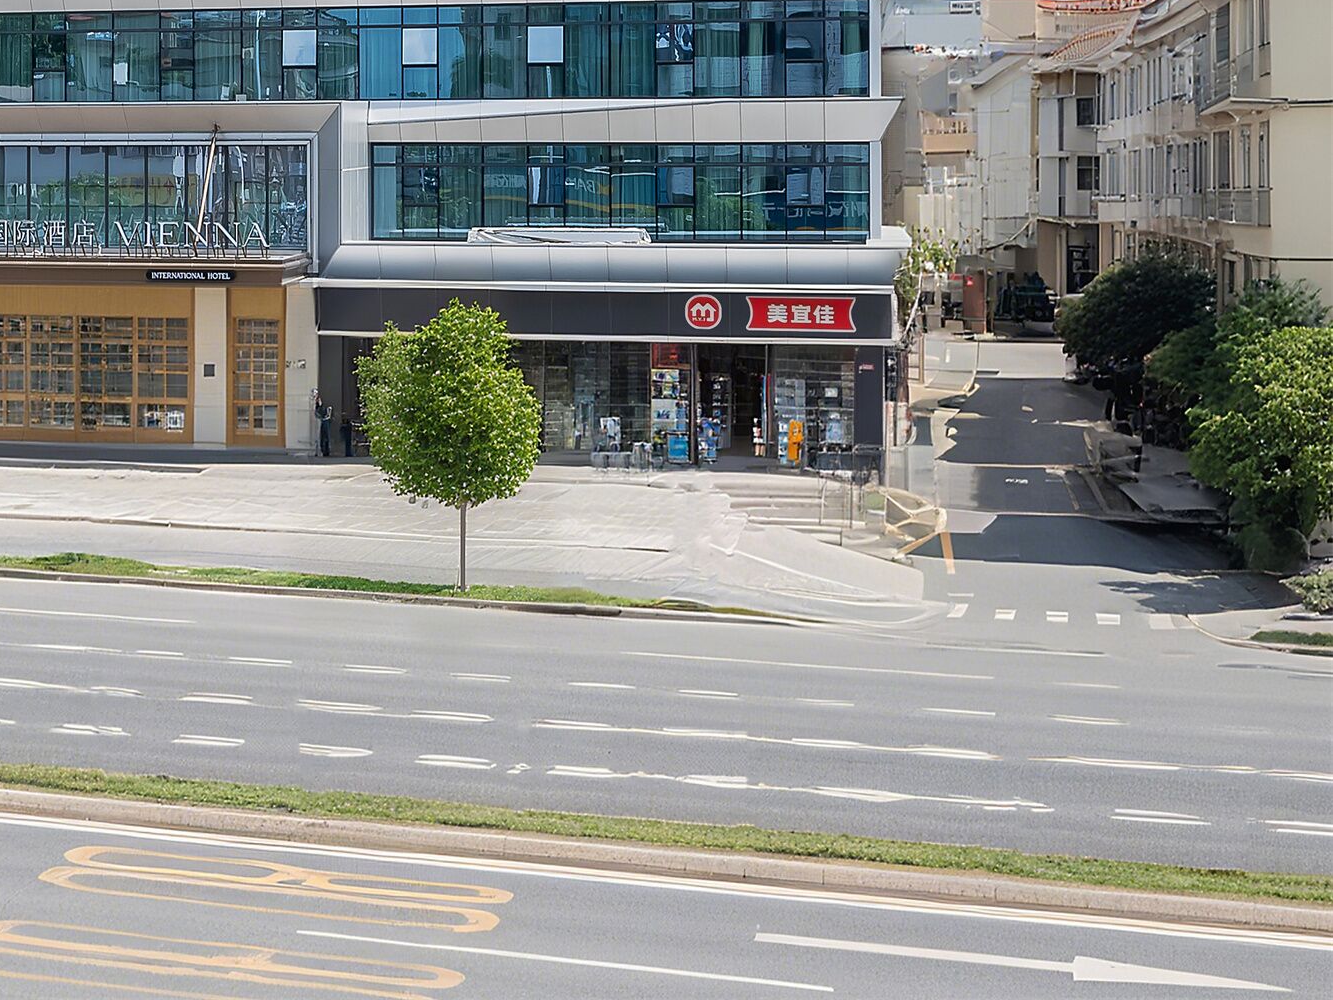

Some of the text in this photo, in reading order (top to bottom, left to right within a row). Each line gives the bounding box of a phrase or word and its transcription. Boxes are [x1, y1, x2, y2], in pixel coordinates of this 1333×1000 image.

[114, 221, 270, 248] VIENNA
[151, 272, 231, 280] INTERNATIONAL HOTEL
[766, 303, 835, 325] 美宜佳
